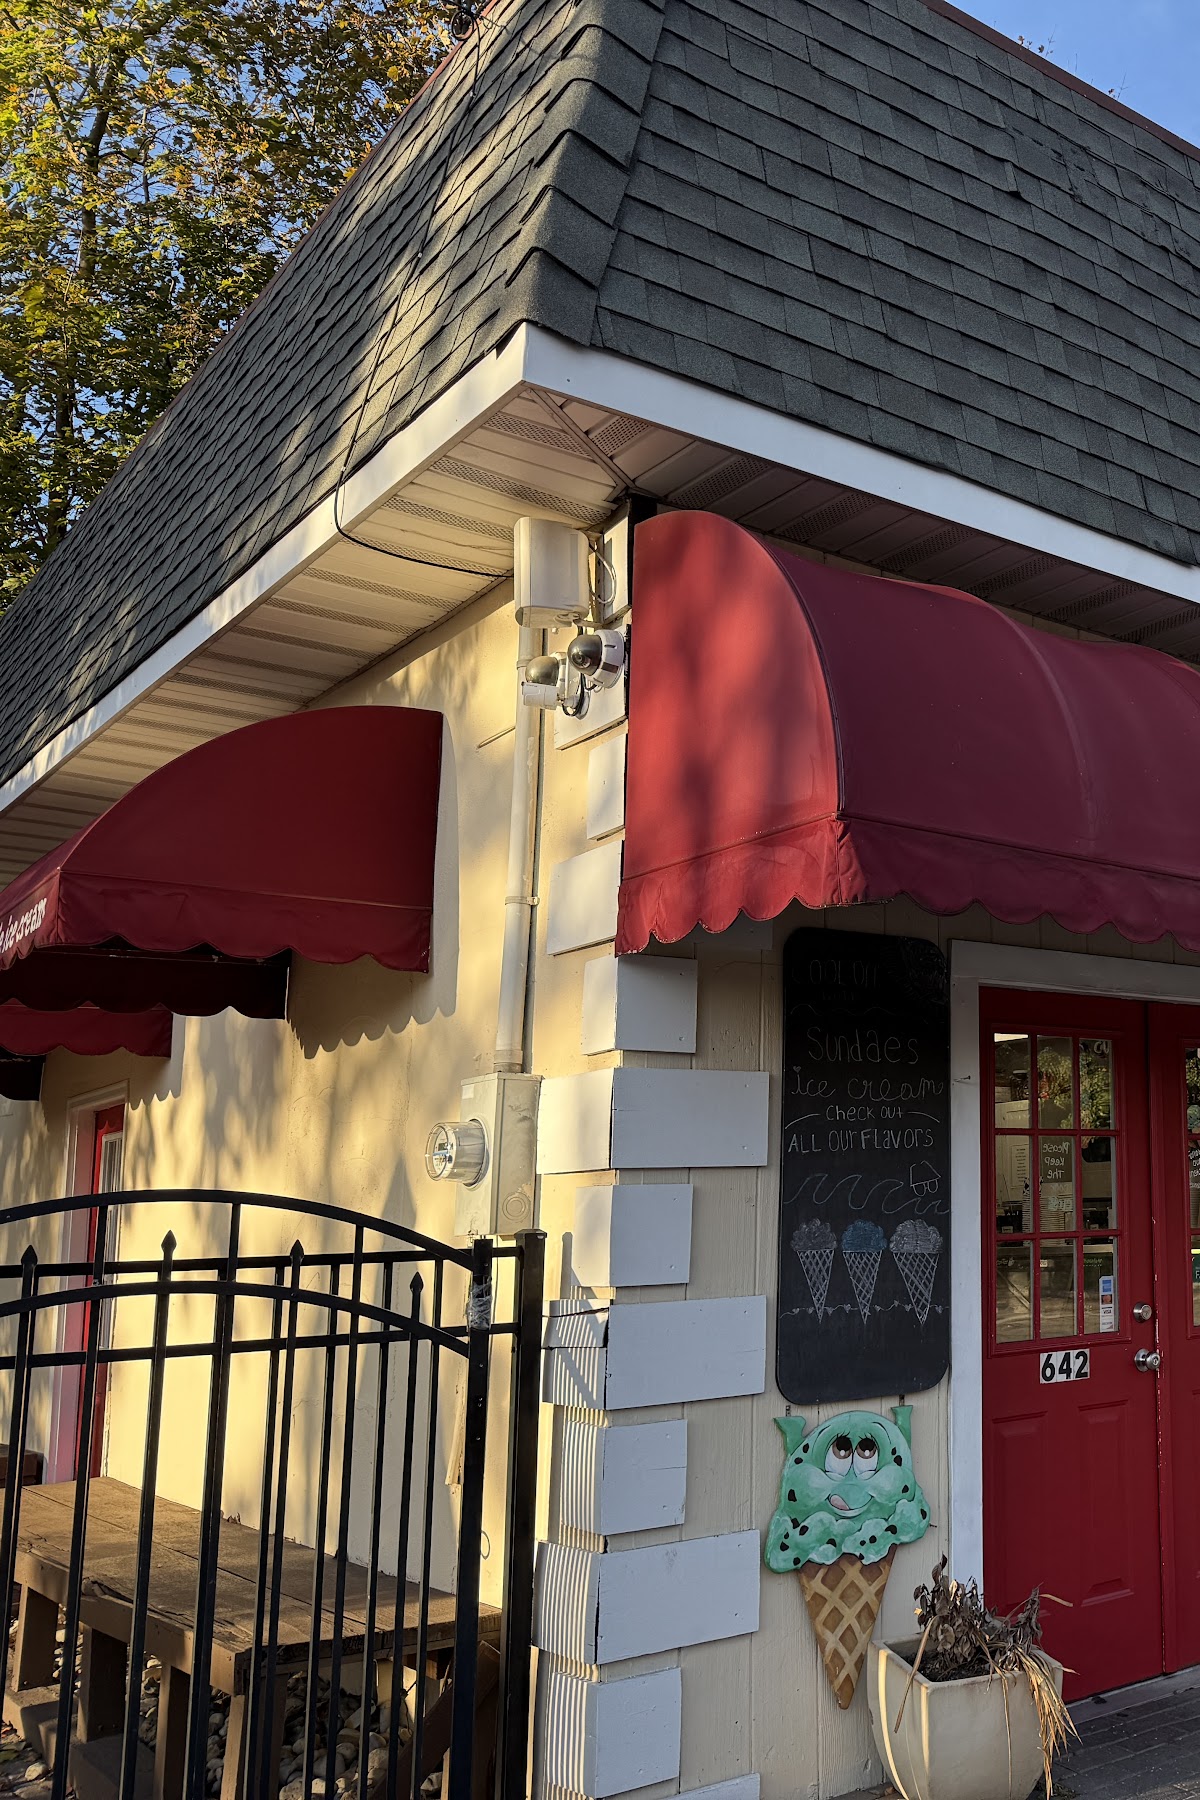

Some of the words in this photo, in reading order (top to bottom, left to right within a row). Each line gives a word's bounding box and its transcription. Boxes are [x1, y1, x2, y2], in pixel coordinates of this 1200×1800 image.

[807, 1026, 919, 1065] Sundaes
[788, 1133, 822, 1153] ALL
[1041, 1351, 1088, 1382] 642
